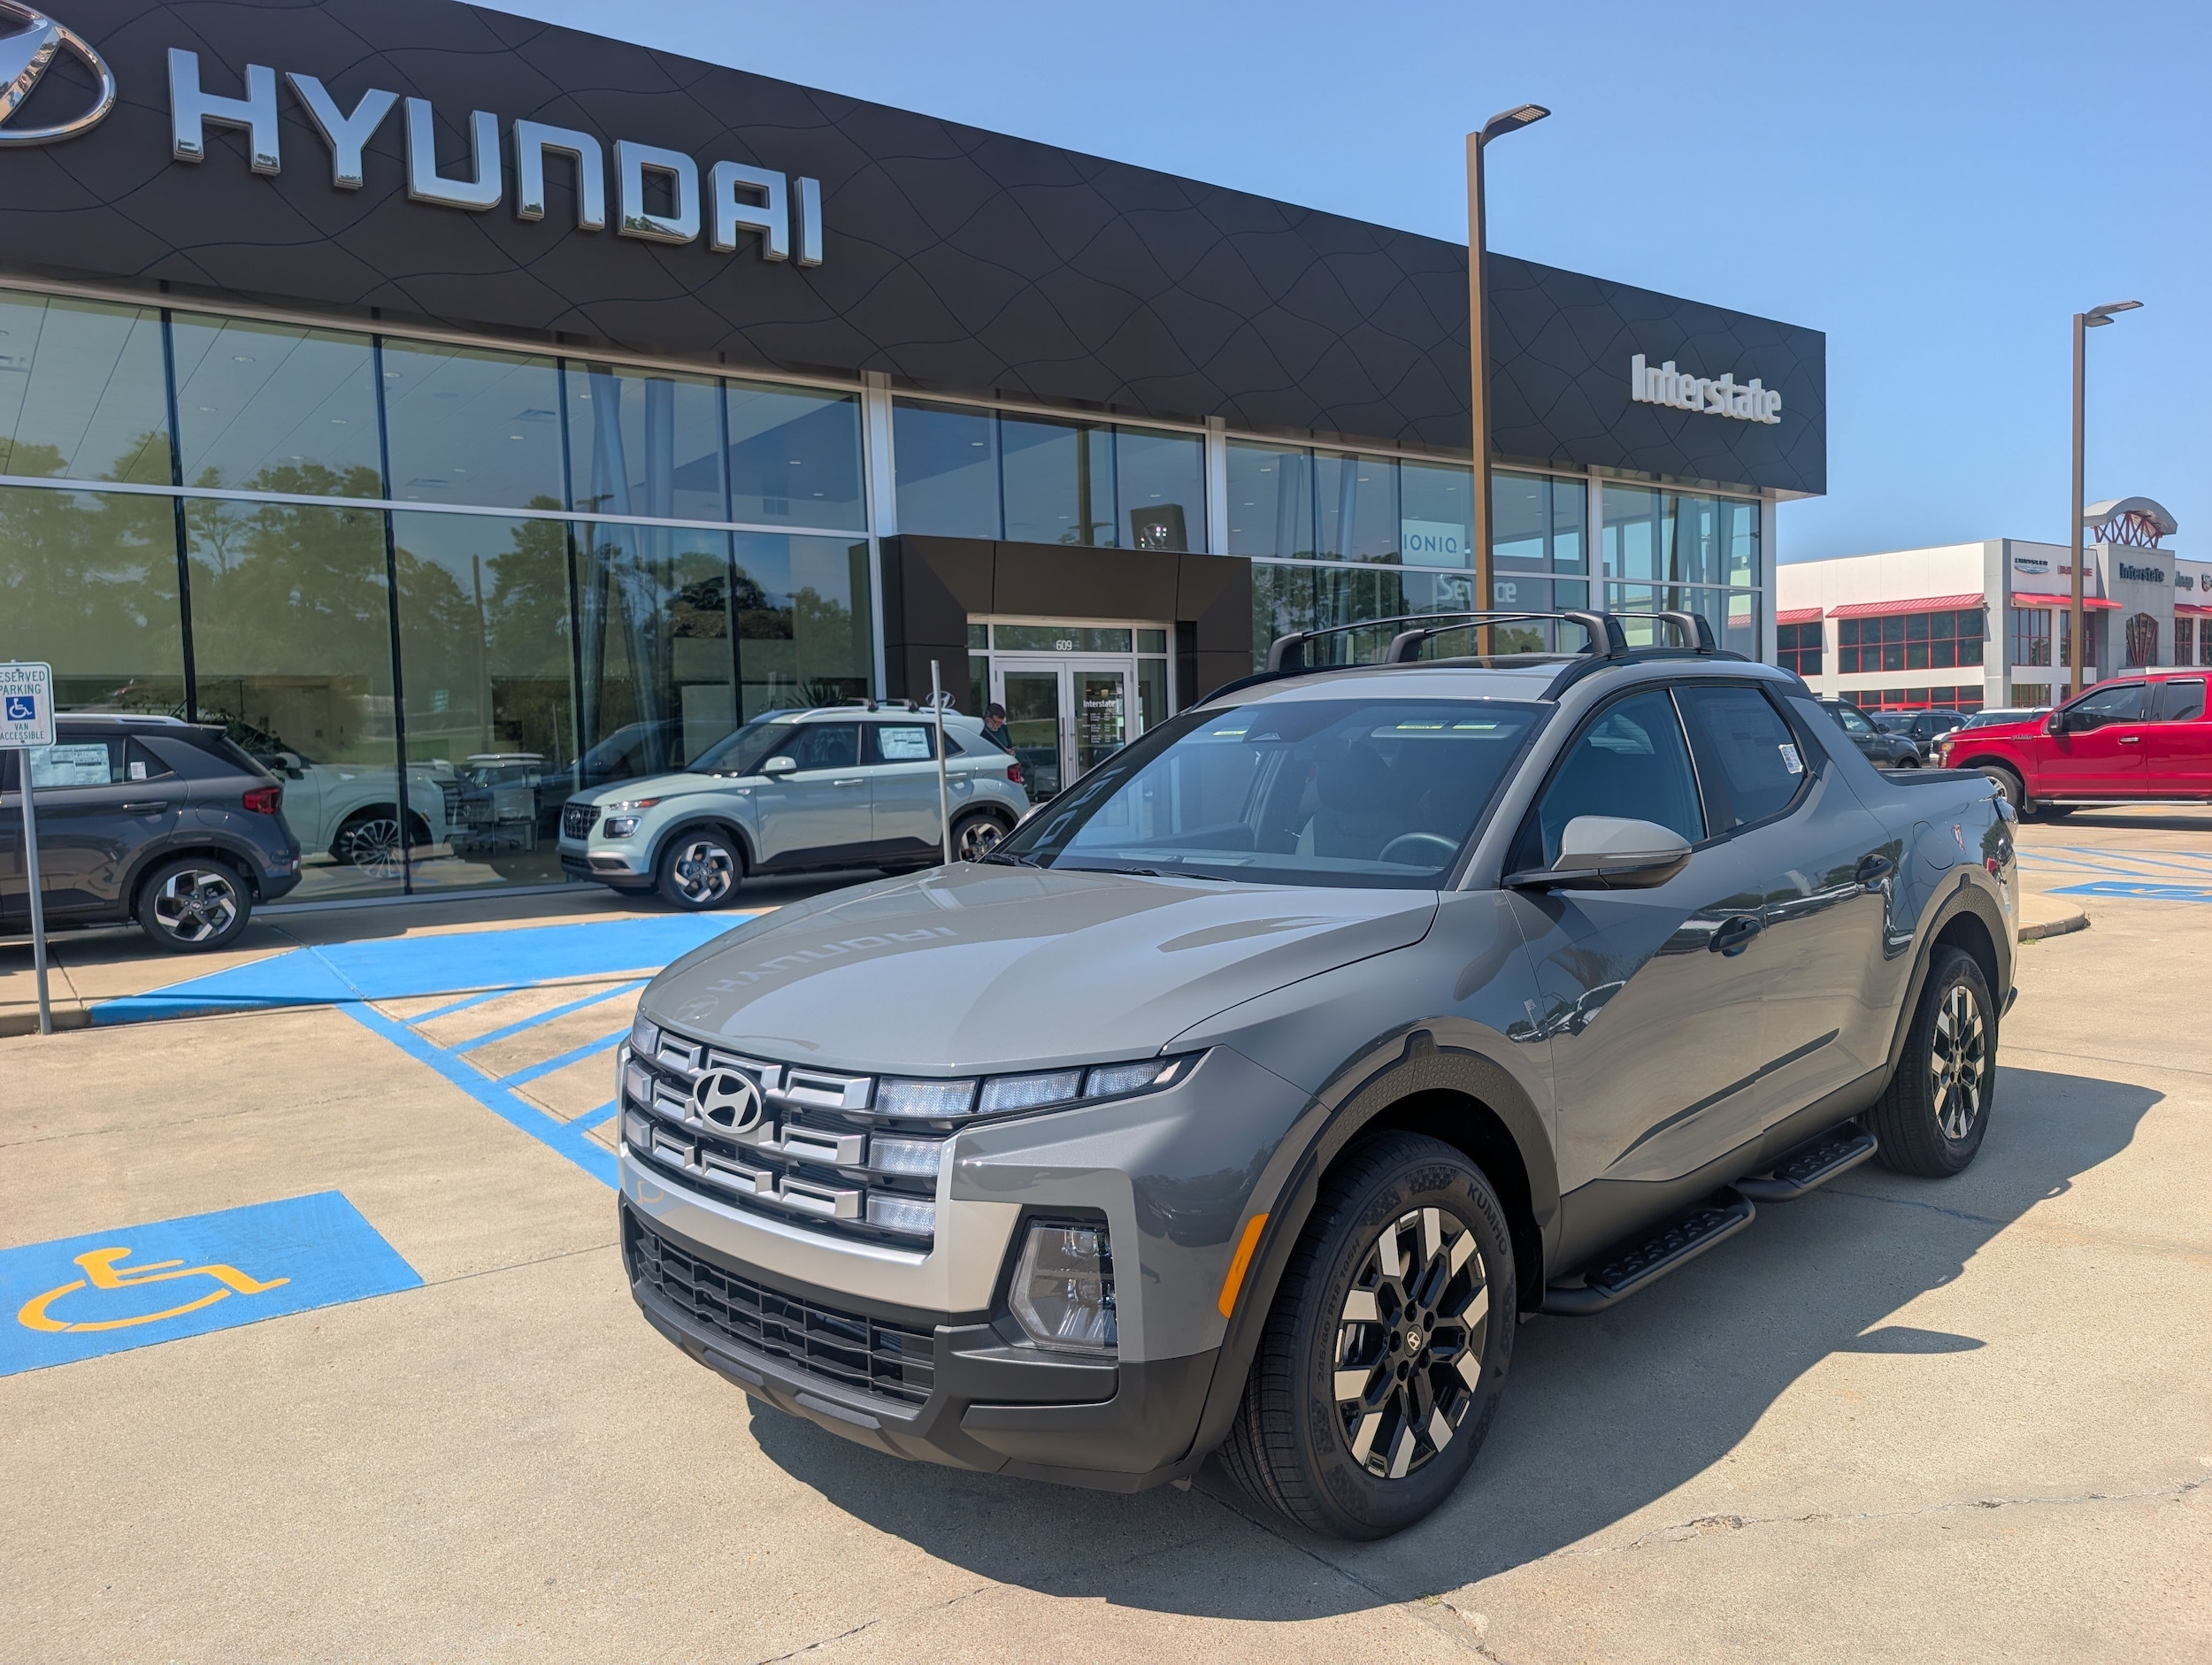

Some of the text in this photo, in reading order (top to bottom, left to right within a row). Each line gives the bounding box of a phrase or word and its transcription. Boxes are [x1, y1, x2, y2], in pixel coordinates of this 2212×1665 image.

[168, 47, 824, 267] HYUNDAI
[1632, 353, 1782, 425] Interstate
[1403, 533, 1457, 554] IONIQ
[2119, 562, 2165, 583] Interstate
[1056, 639, 1072, 651] 609
[1082, 699, 1117, 709] Interstate
[0, 731, 45, 740] ACCESSIBLE
[1467, 1182, 1508, 1256] KUMHO
[1317, 1321, 1332, 1383] 245/60
[1327, 1284, 1342, 1318] R18
